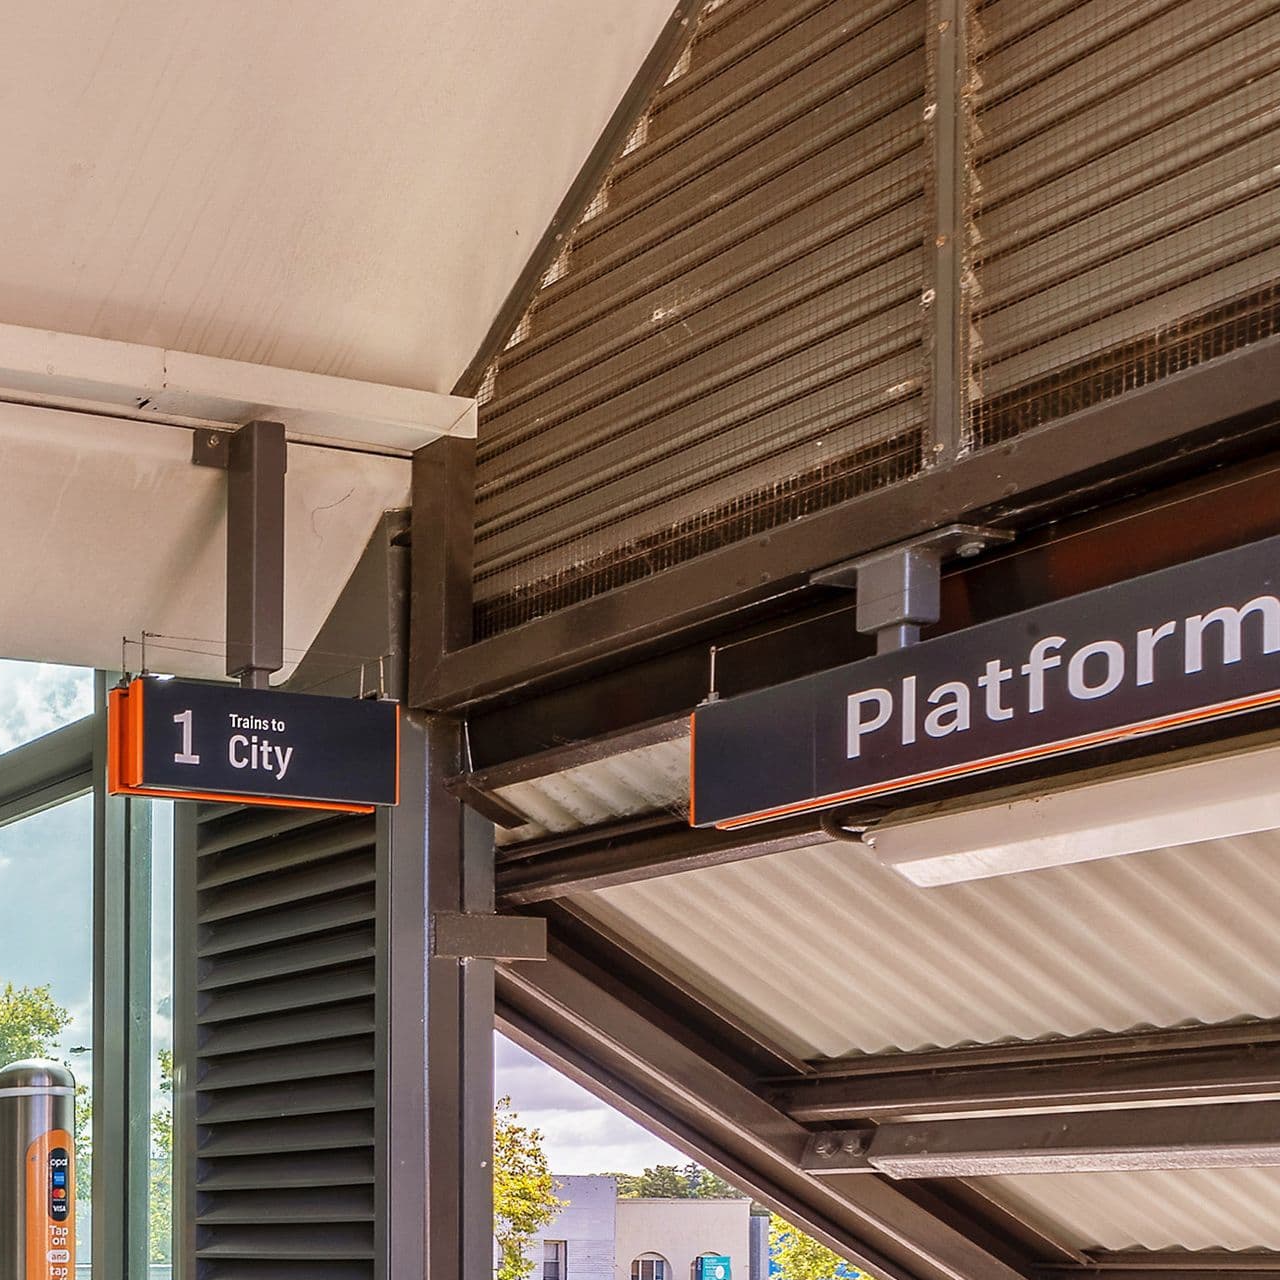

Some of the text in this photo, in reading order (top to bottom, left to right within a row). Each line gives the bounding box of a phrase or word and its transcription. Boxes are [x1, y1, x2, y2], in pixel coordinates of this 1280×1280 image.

[846, 595, 1280, 760] Platform
[229, 712, 286, 732] Trains to
[173, 709, 200, 765] 1
[228, 734, 294, 780] City
[49, 1225, 69, 1238] Tap
[52, 1237, 66, 1246] on
[50, 1252, 67, 1261] and
[49, 1266, 69, 1278] tap
